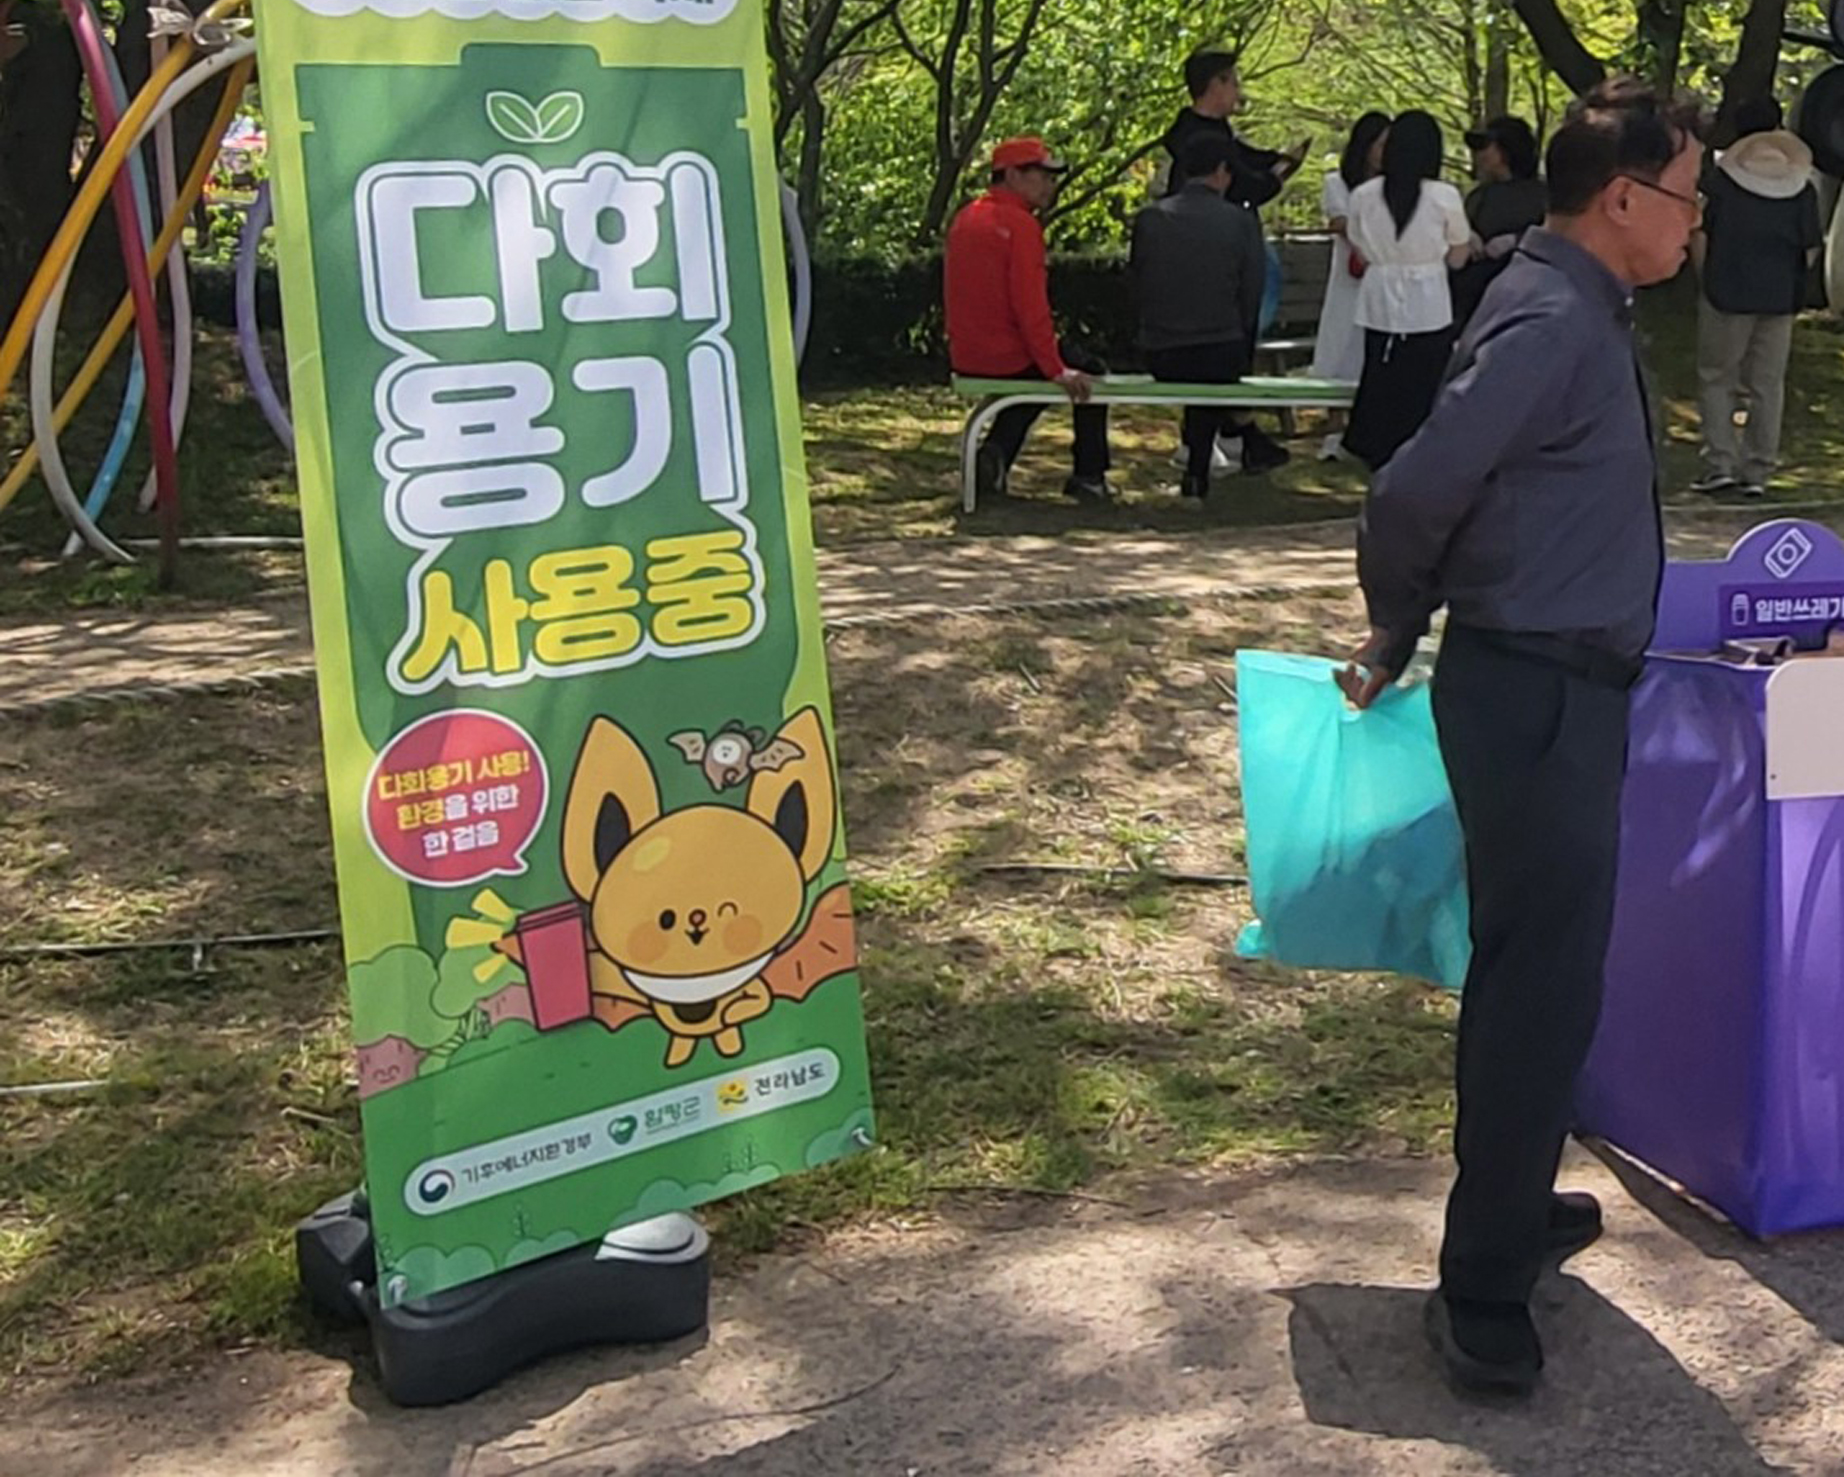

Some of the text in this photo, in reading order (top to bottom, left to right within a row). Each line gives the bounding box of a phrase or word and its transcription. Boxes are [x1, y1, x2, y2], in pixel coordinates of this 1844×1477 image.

[369, 160, 719, 332] 다회
[385, 344, 736, 535] 용기
[401, 530, 753, 681] 사용중
[377, 750, 531, 801] 다회용기 사용!
[396, 784, 519, 830] 환경을 위한
[422, 820, 499, 859] 한 걸음
[754, 1061, 826, 1097] 전라남도
